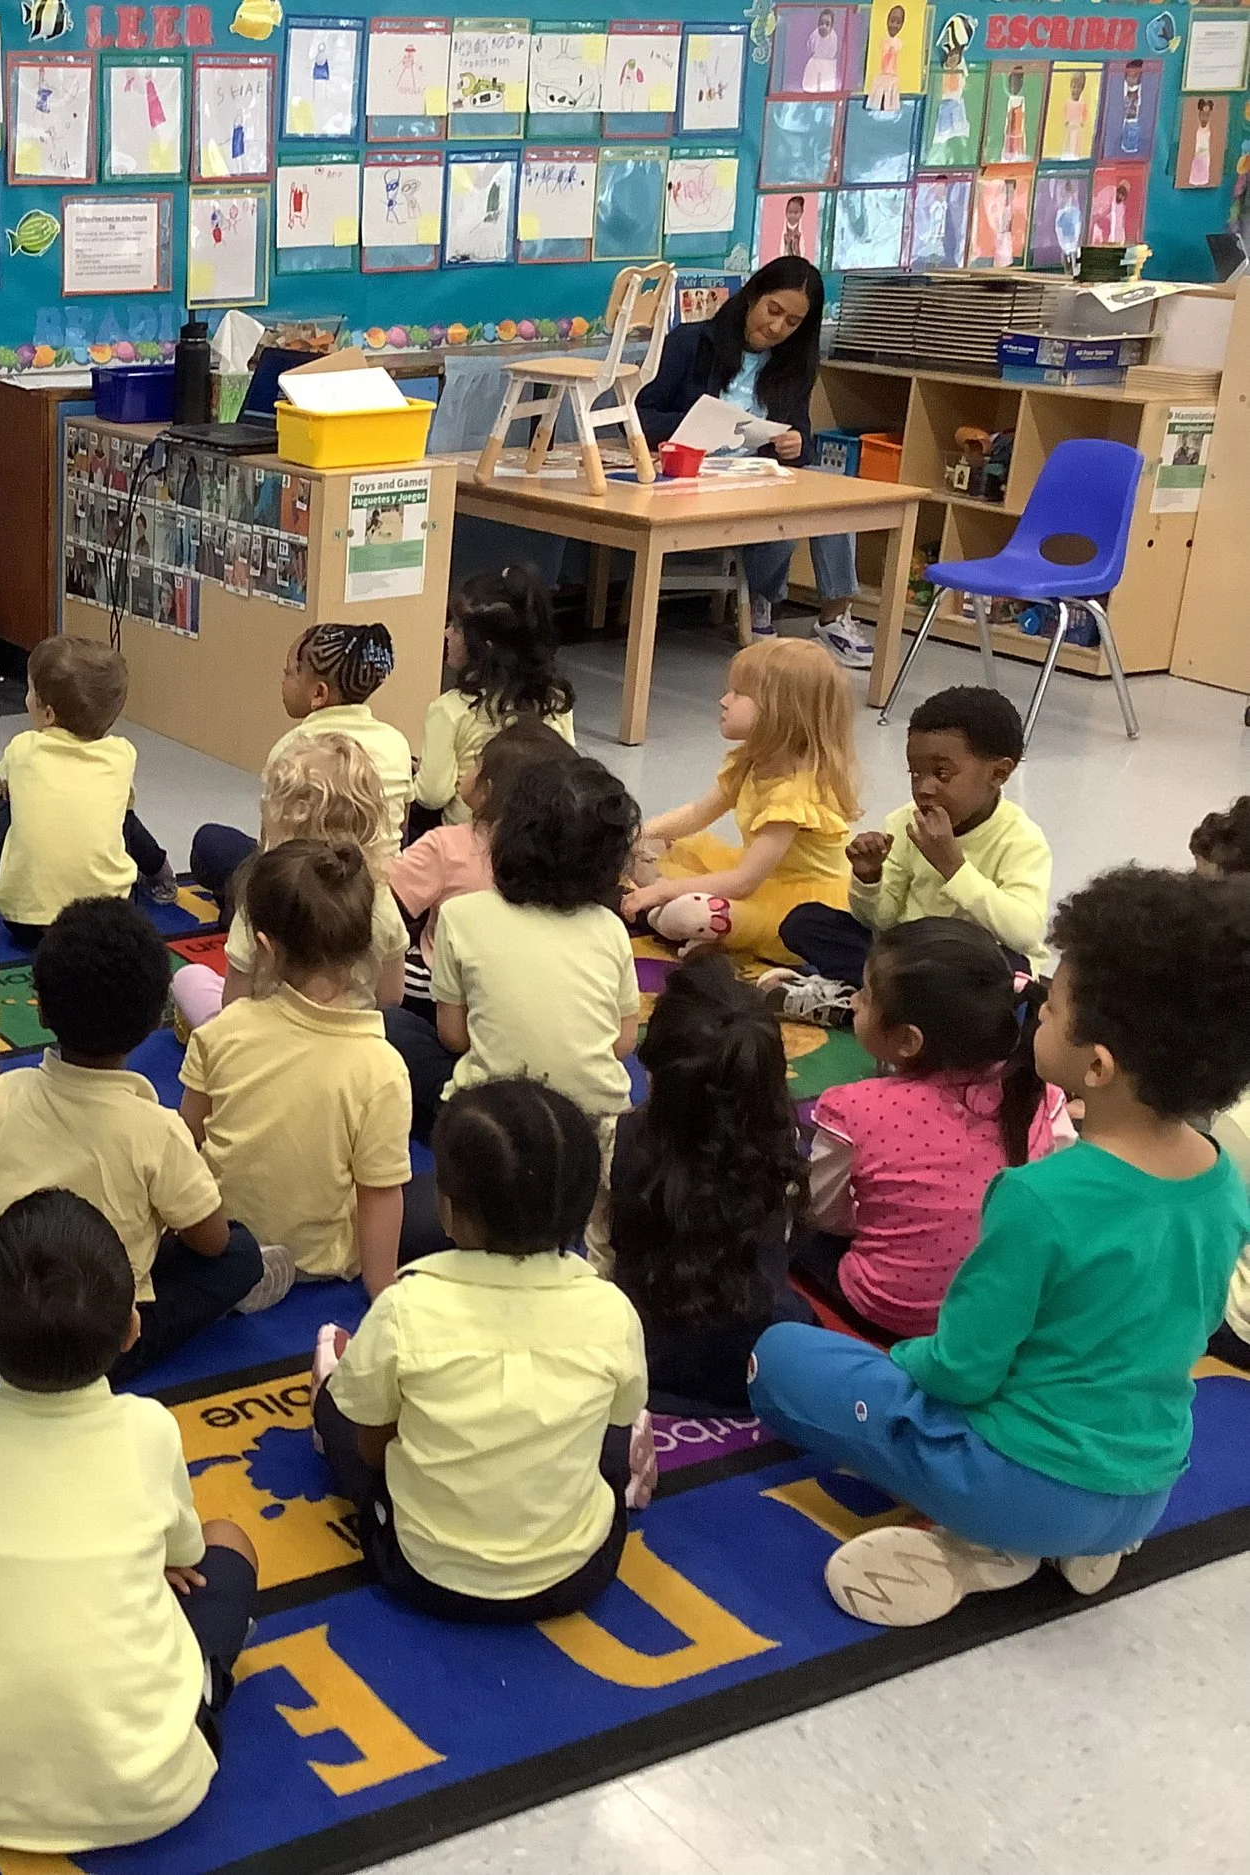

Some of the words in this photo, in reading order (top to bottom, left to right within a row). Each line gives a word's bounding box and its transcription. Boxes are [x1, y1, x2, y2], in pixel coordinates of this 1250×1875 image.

[84, 4, 215, 49] LEER
[353, 482, 375, 494] Toys
[378, 479, 395, 490] and
[396, 477, 429, 489] Games
[353, 494, 391, 507] Juguetes
[398, 491, 426, 503] Juegos
